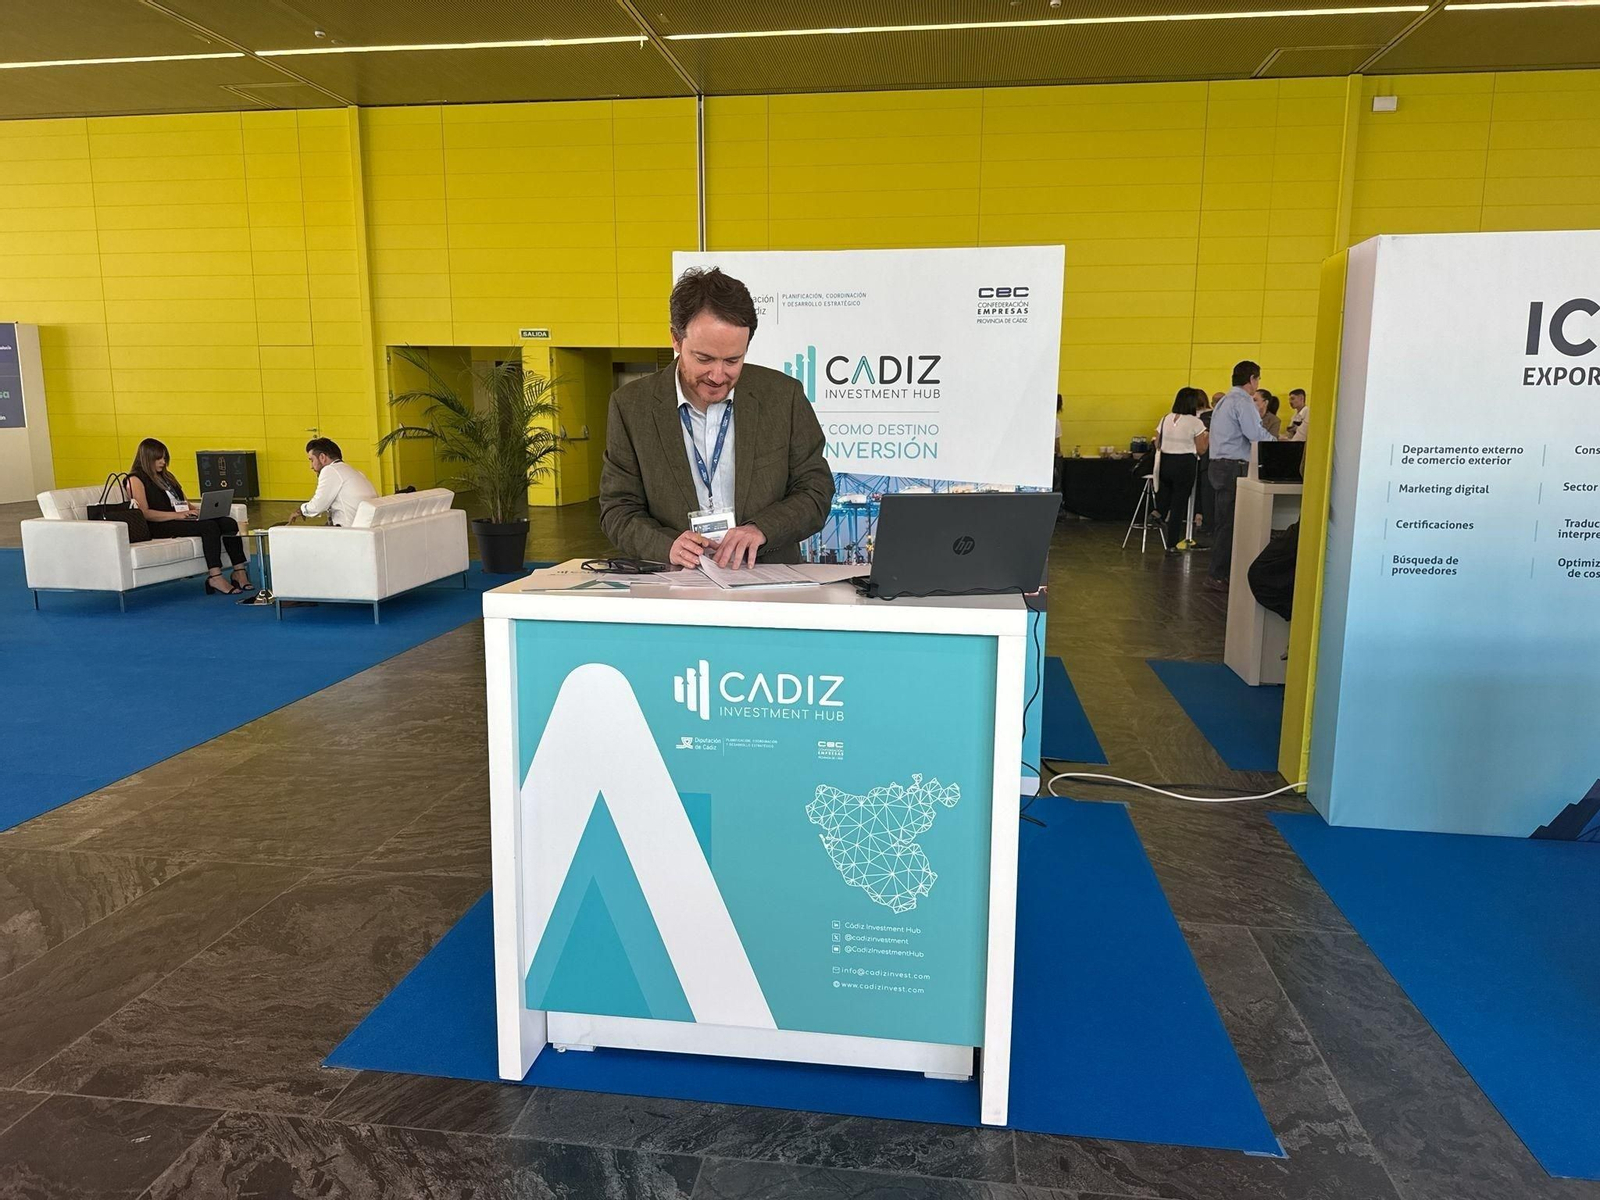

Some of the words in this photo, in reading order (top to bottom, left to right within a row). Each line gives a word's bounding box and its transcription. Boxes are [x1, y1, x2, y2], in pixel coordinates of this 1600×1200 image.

[826, 355, 941, 385] CADIZ
[825, 388, 908, 398] INVESTMENT
[913, 388, 941, 398] HUB
[828, 424, 873, 435] COMO
[878, 424, 939, 435] DESTINO
[1402, 444, 1479, 456] Departamento
[1481, 446, 1524, 454] externo
[1401, 456, 1414, 465] de
[1417, 457, 1466, 465] comercio
[1468, 456, 1512, 465] exterior
[1399, 485, 1452, 496] Marketing
[1454, 485, 1490, 496] digital
[1563, 482, 1598, 492] Sector
[1396, 520, 1474, 530] Certificaciones
[955, 536, 973, 555] hp
[1393, 556, 1443, 567] Búsqueda
[1446, 556, 1459, 565] de
[1392, 567, 1457, 576] proveedores
[1567, 569, 1581, 578] de
[720, 672, 844, 706] CADIZ
[720, 706, 809, 720] INVESTMENT
[815, 710, 844, 721] HUB
[866, 924, 904, 932] Investment
[844, 934, 908, 944] @cadizinvestment
[844, 946, 924, 958] @CadizInvestmentHub
[842, 967, 930, 980] info@cadizinvest.com
[842, 982, 924, 994] www.cadizinvest.com
